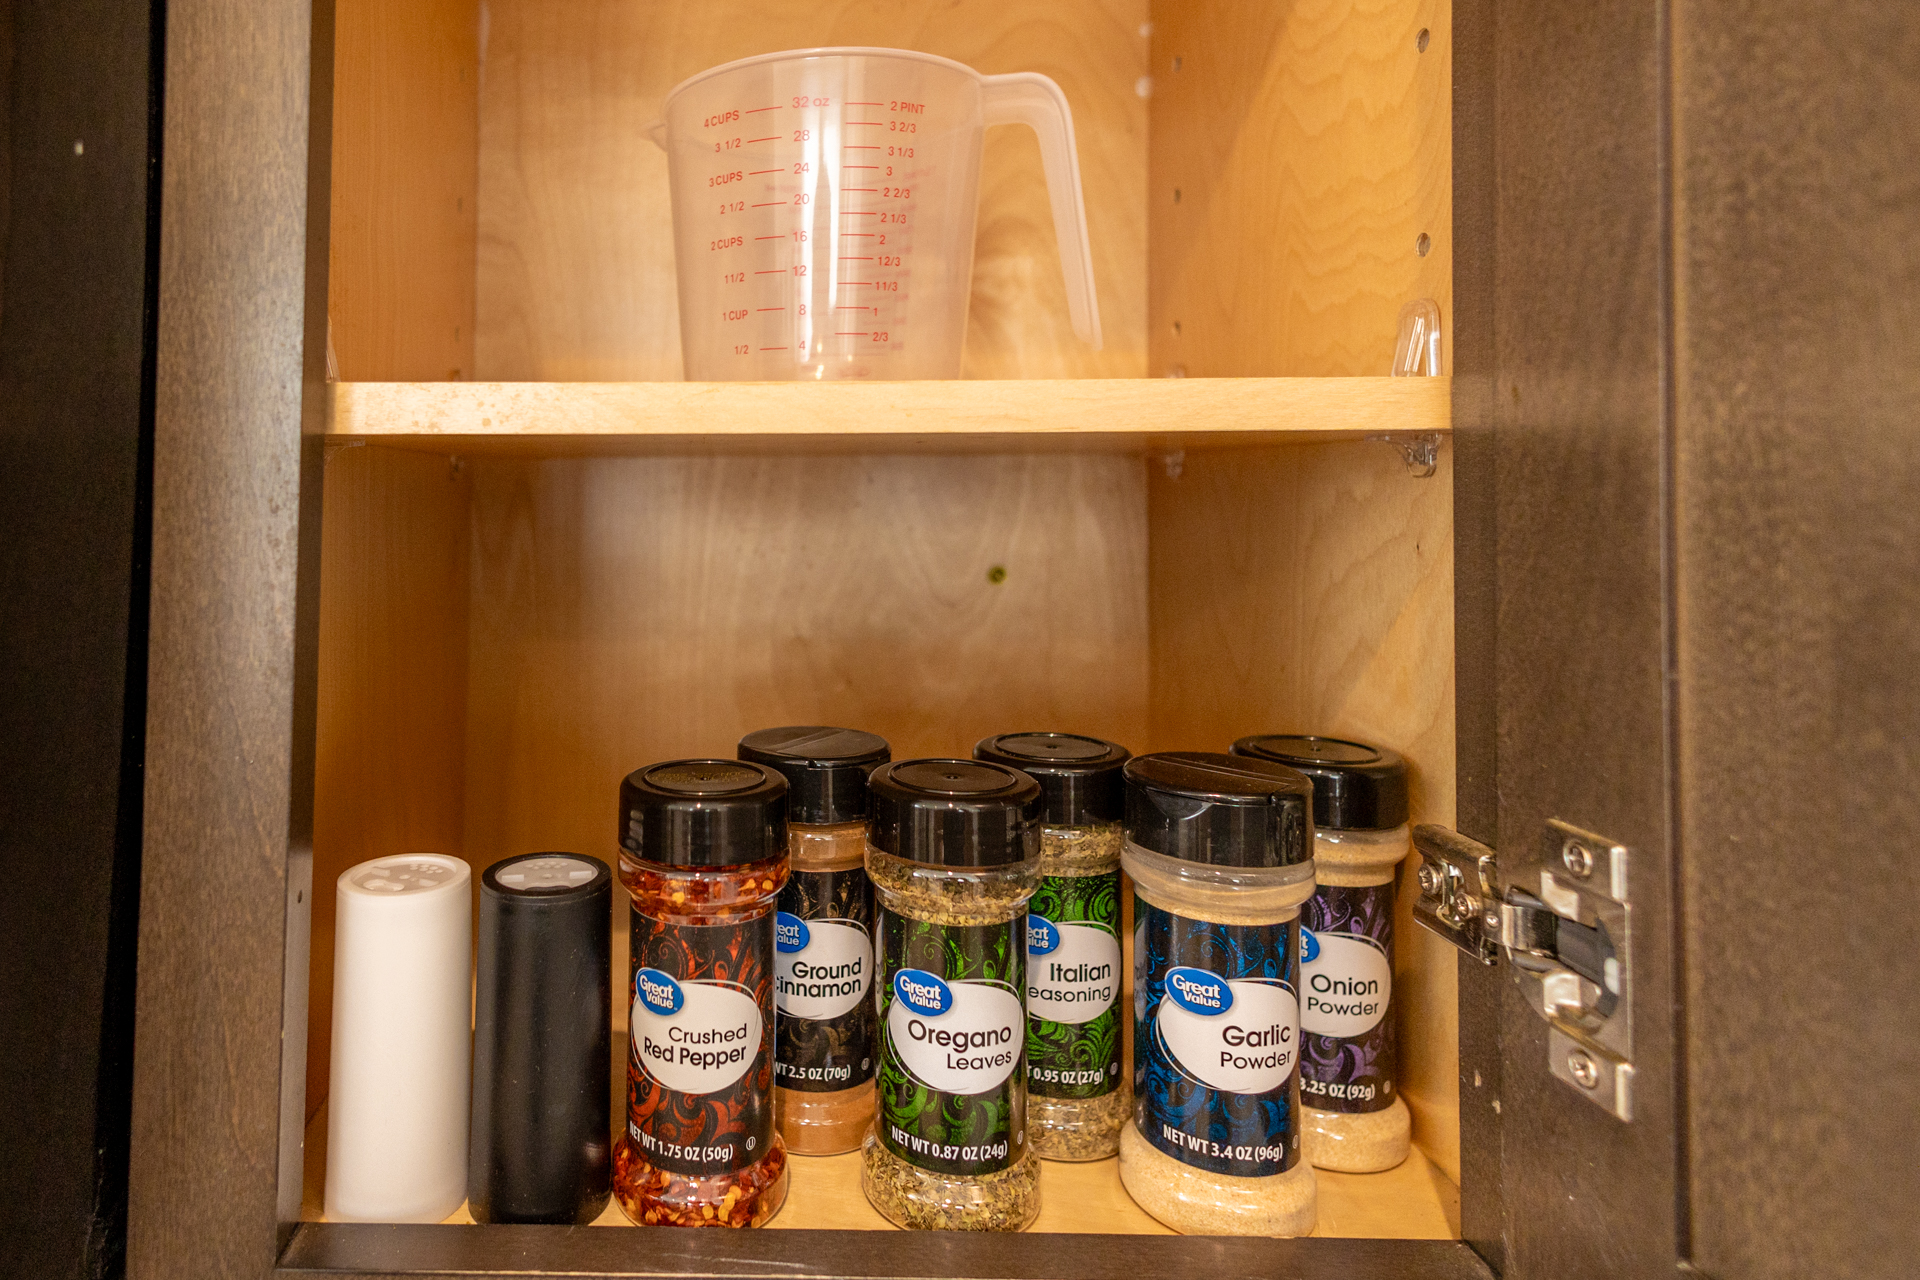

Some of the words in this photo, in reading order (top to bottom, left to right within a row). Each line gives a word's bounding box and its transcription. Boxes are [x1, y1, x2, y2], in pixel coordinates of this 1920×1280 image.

[792, 96, 810, 109] 32
[890, 101, 898, 112] 2
[900, 101, 926, 115] PINT
[793, 130, 811, 142] 28
[889, 121, 897, 131] 3
[898, 121, 917, 134] 2/3
[714, 143, 721, 153] 3
[724, 138, 741, 151] 1/2
[887, 146, 895, 156] 3
[897, 147, 914, 159] 1/3
[793, 163, 810, 174] 24
[886, 166, 893, 177] 3
[793, 193, 810, 205] 20
[883, 187, 890, 198] 2
[893, 188, 911, 200] 2/3
[719, 204, 726, 215] 2
[729, 201, 745, 213] 1/2
[880, 212, 887, 223] 2
[891, 213, 907, 225] 1/3
[792, 231, 808, 243] 16
[879, 235, 886, 245] 2
[792, 265, 807, 277] 12
[798, 304, 807, 316] 8
[873, 307, 878, 317] 1
[872, 331, 889, 342] 2/3
[734, 344, 749, 355] 1/2
[798, 340, 806, 351] 4
[777, 924, 800, 938] eat
[777, 934, 800, 946] alue
[792, 956, 862, 980] Ground
[1050, 963, 1111, 983] Italian
[639, 974, 674, 1000] Great
[776, 976, 862, 998] innamon
[899, 975, 942, 1001] Great
[1172, 974, 1221, 999] Great
[1310, 974, 1378, 996] Onion
[646, 991, 674, 1010] Value
[908, 992, 942, 1010] Value
[1028, 986, 1111, 1003] easoning
[1183, 990, 1221, 1008] Value
[1307, 996, 1379, 1017] Powder
[668, 1023, 747, 1045] Crushed
[908, 1019, 1012, 1054] Oregano
[1222, 1024, 1291, 1048] Garlic
[644, 1036, 674, 1063] Red
[679, 1045, 747, 1071] Pepper
[947, 1051, 1012, 1070] Leaves
[1220, 1051, 1291, 1070] Powder
[788, 1065, 806, 1079] 2.5
[808, 1067, 823, 1080] OZ
[824, 1064, 851, 1082] (70g)
[1033, 1067, 1059, 1083] 0.95
[1061, 1071, 1076, 1084] OZ
[1077, 1067, 1104, 1085] (27g)
[1328, 1083, 1346, 1098] OZ
[1346, 1083, 1376, 1101] (92g)
[629, 1120, 642, 1143] NET
[642, 1131, 656, 1152] WT
[658, 1140, 682, 1159] 1.75
[684, 1146, 700, 1161] OZ
[702, 1143, 734, 1163] (50g)
[891, 1124, 910, 1147] NET
[911, 1135, 930, 1155] WT
[931, 1143, 960, 1160] 0.87
[962, 1146, 978, 1161] OZ
[980, 1139, 1008, 1162] (24g)
[1163, 1123, 1186, 1147] NET
[1187, 1134, 1209, 1154] WT
[1211, 1142, 1233, 1159] 3.4
[1235, 1146, 1253, 1161] OZ
[1254, 1142, 1284, 1163] (96g)
